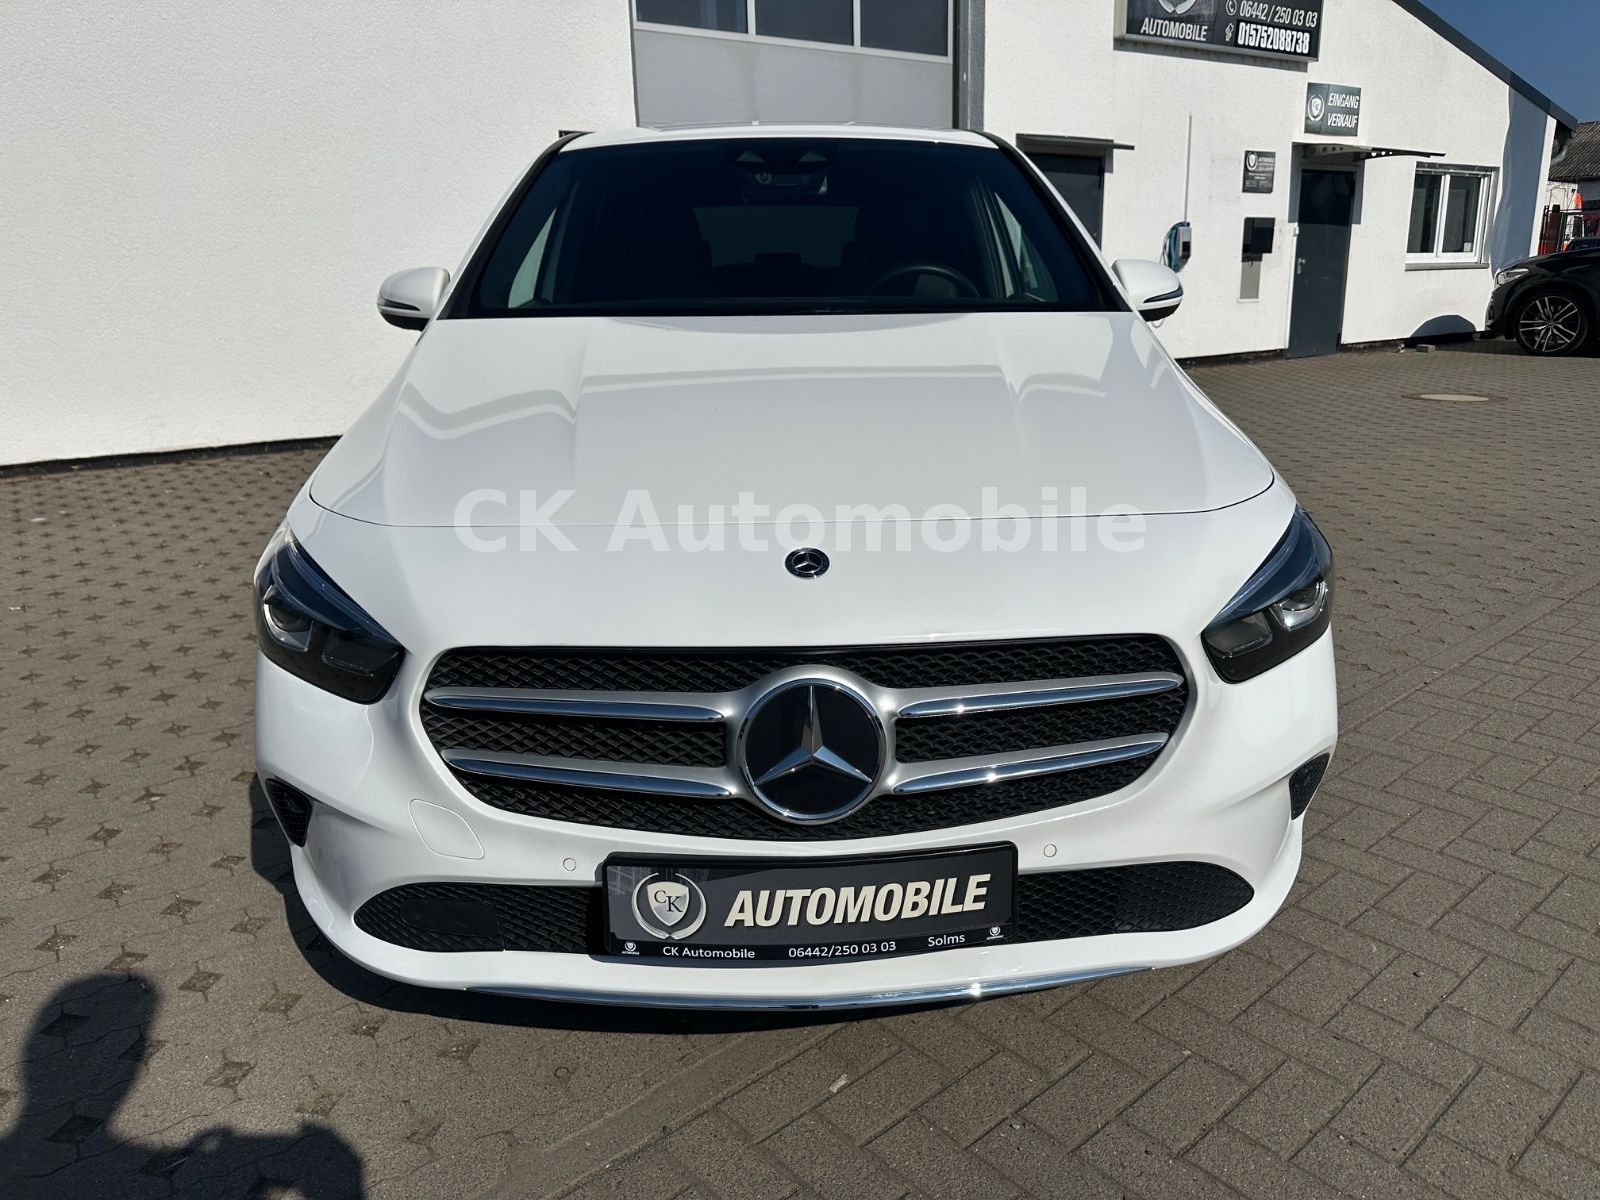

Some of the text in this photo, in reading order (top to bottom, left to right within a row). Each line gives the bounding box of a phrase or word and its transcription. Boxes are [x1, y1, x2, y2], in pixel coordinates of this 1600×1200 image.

[1240, 0, 1268, 20] 06442
[1274, 6, 1291, 24] 250
[1292, 9, 1304, 26] 03
[1305, 11, 1318, 27] 03
[1140, 17, 1208, 41] AUTOMOBILE
[1237, 22, 1310, 54] 015752088738
[1327, 92, 1360, 109] EINGANG
[1327, 113, 1358, 128] VERKAUF
[724, 874, 992, 927] AUTOMOBILE
[928, 932, 965, 947] Solms
[663, 946, 756, 959] CK Automobile
[788, 941, 896, 958] 06442/250 03 03
